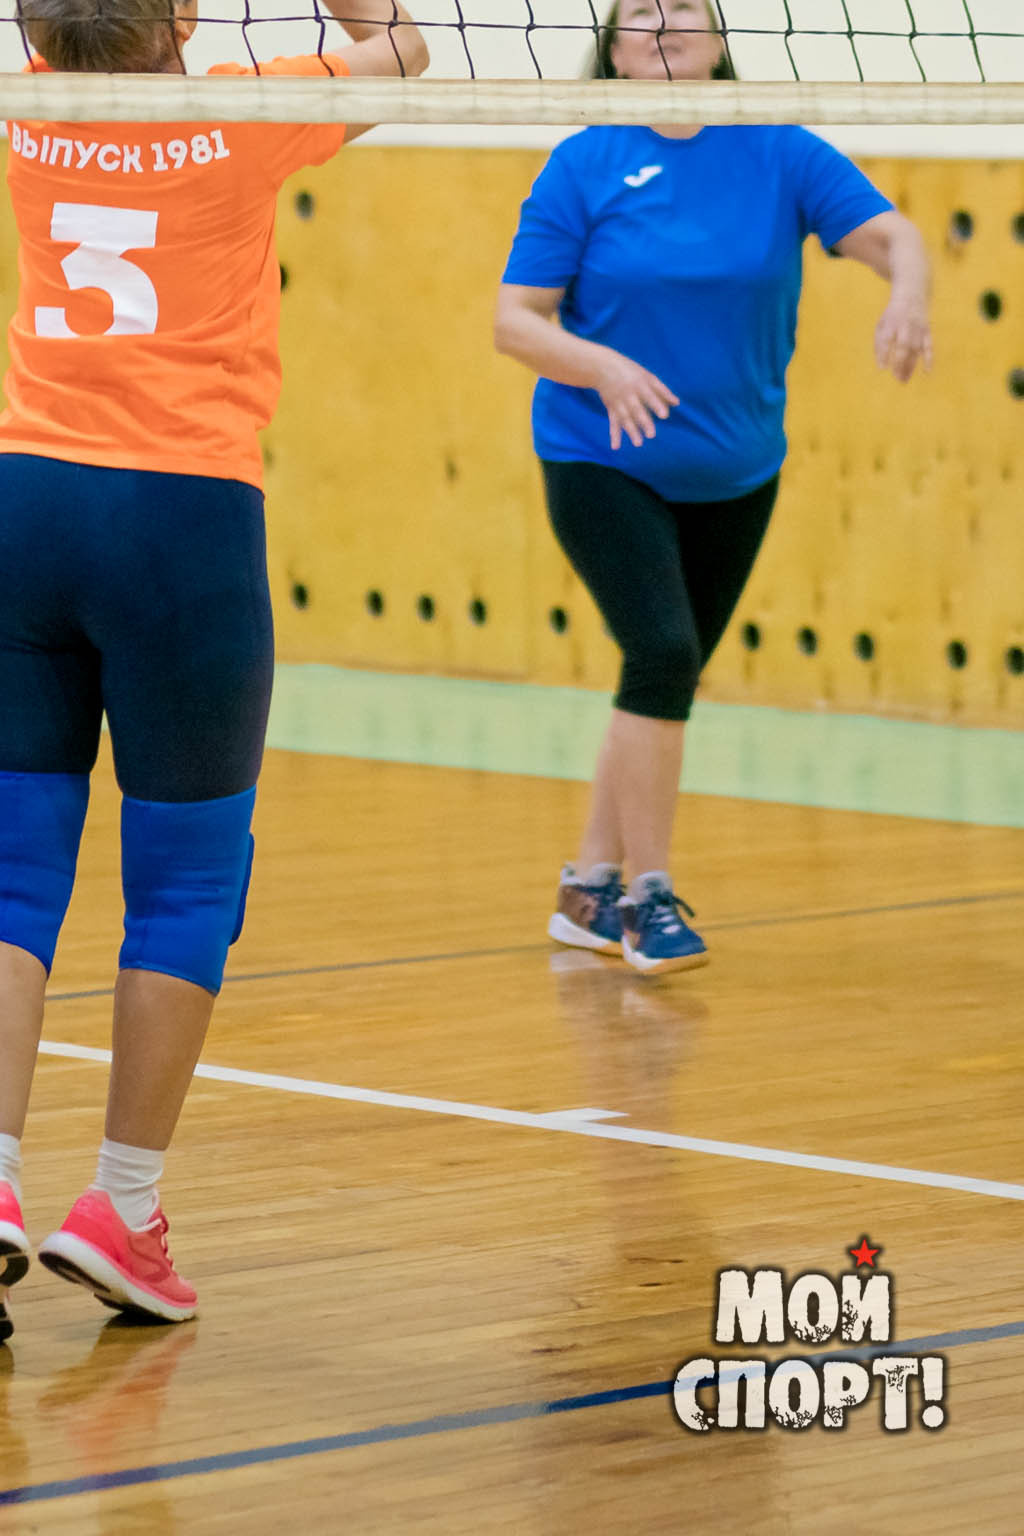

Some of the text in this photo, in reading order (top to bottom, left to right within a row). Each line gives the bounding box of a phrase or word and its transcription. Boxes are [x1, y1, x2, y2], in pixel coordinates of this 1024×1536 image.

[12, 123, 230, 173] ВЫПУСК 1981
[35, 202, 158, 338] 3
